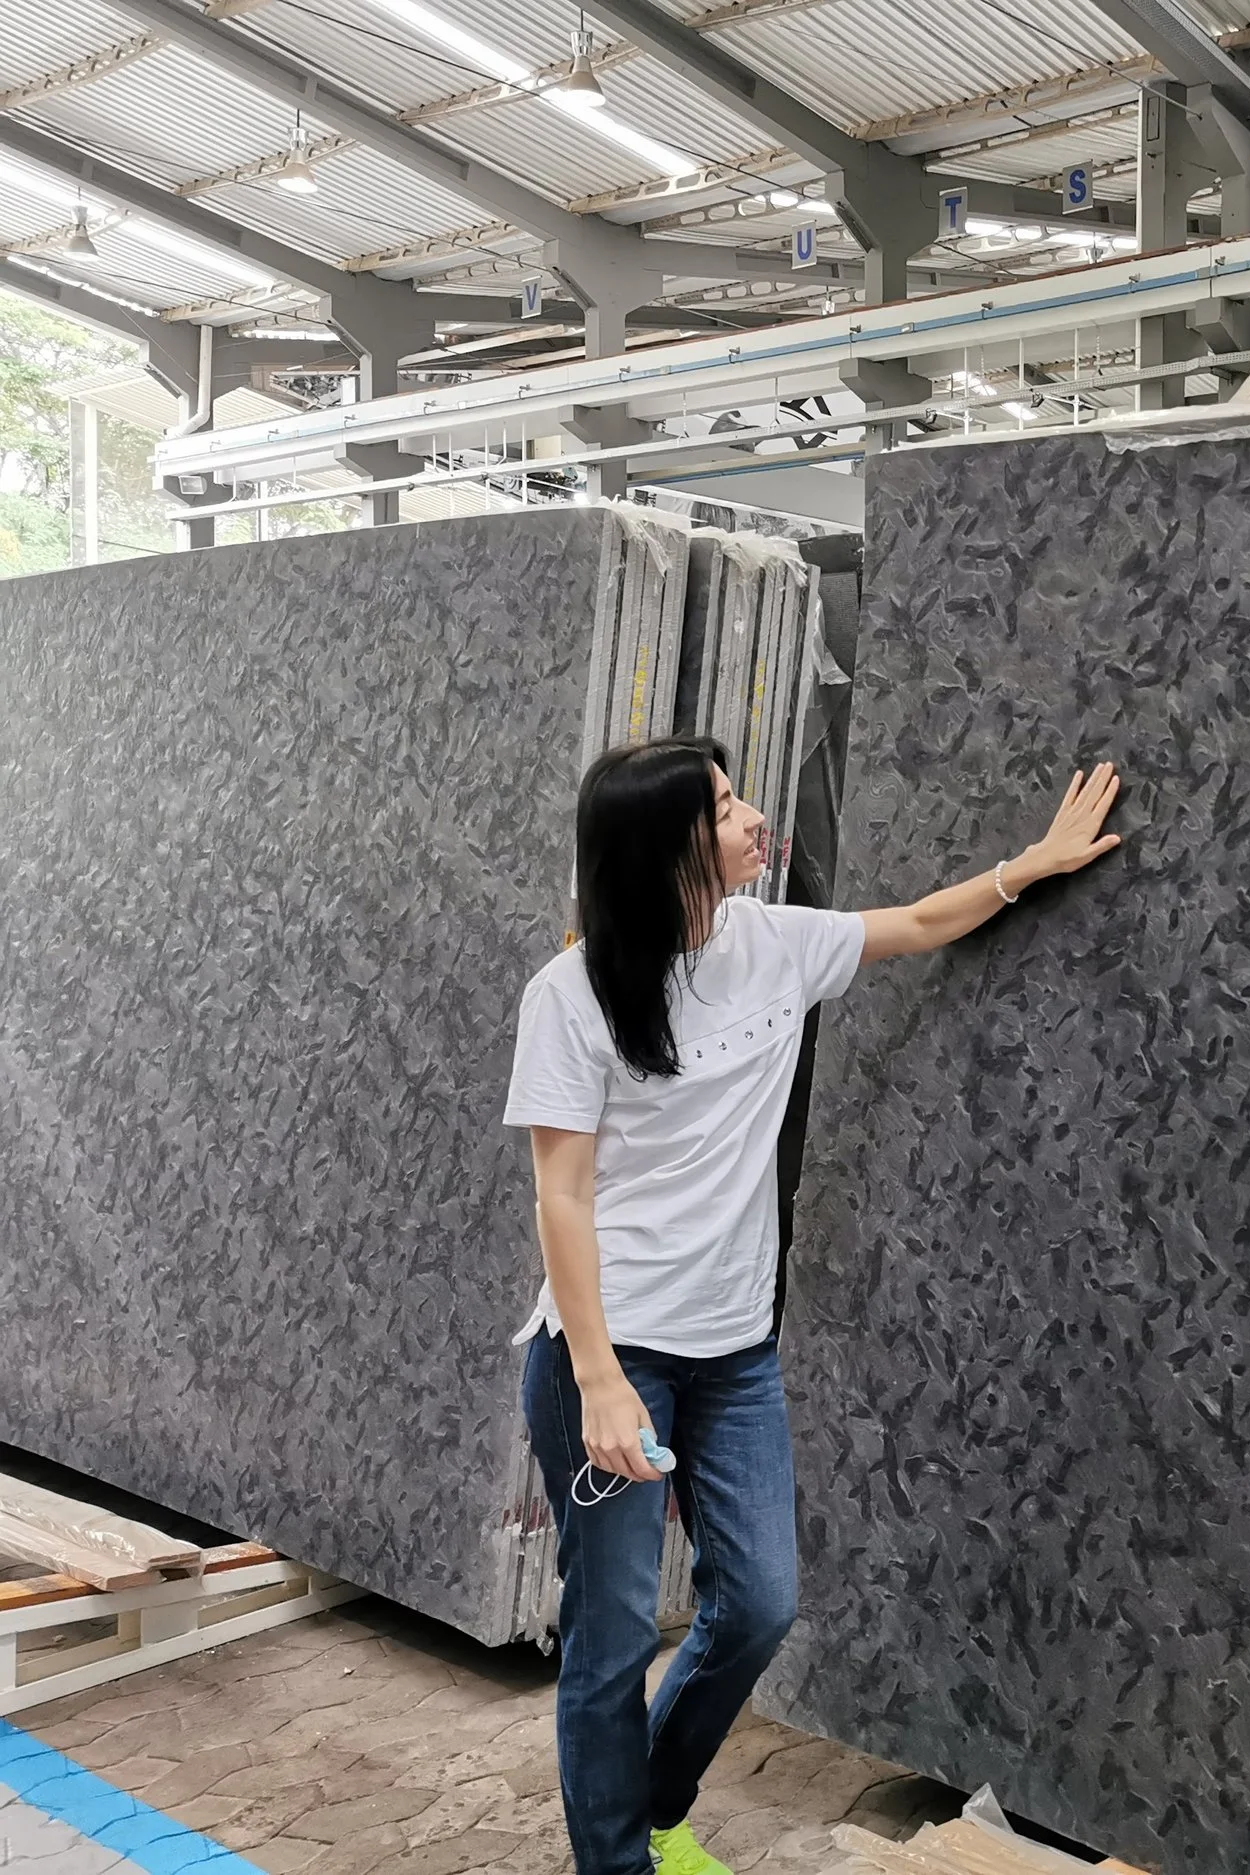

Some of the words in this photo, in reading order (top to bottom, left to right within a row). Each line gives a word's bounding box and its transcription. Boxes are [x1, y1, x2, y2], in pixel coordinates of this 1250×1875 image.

[1069, 169, 1086, 203] S
[945, 196, 962, 228] T
[797, 229, 812, 260] U
[525, 283, 538, 310] V
